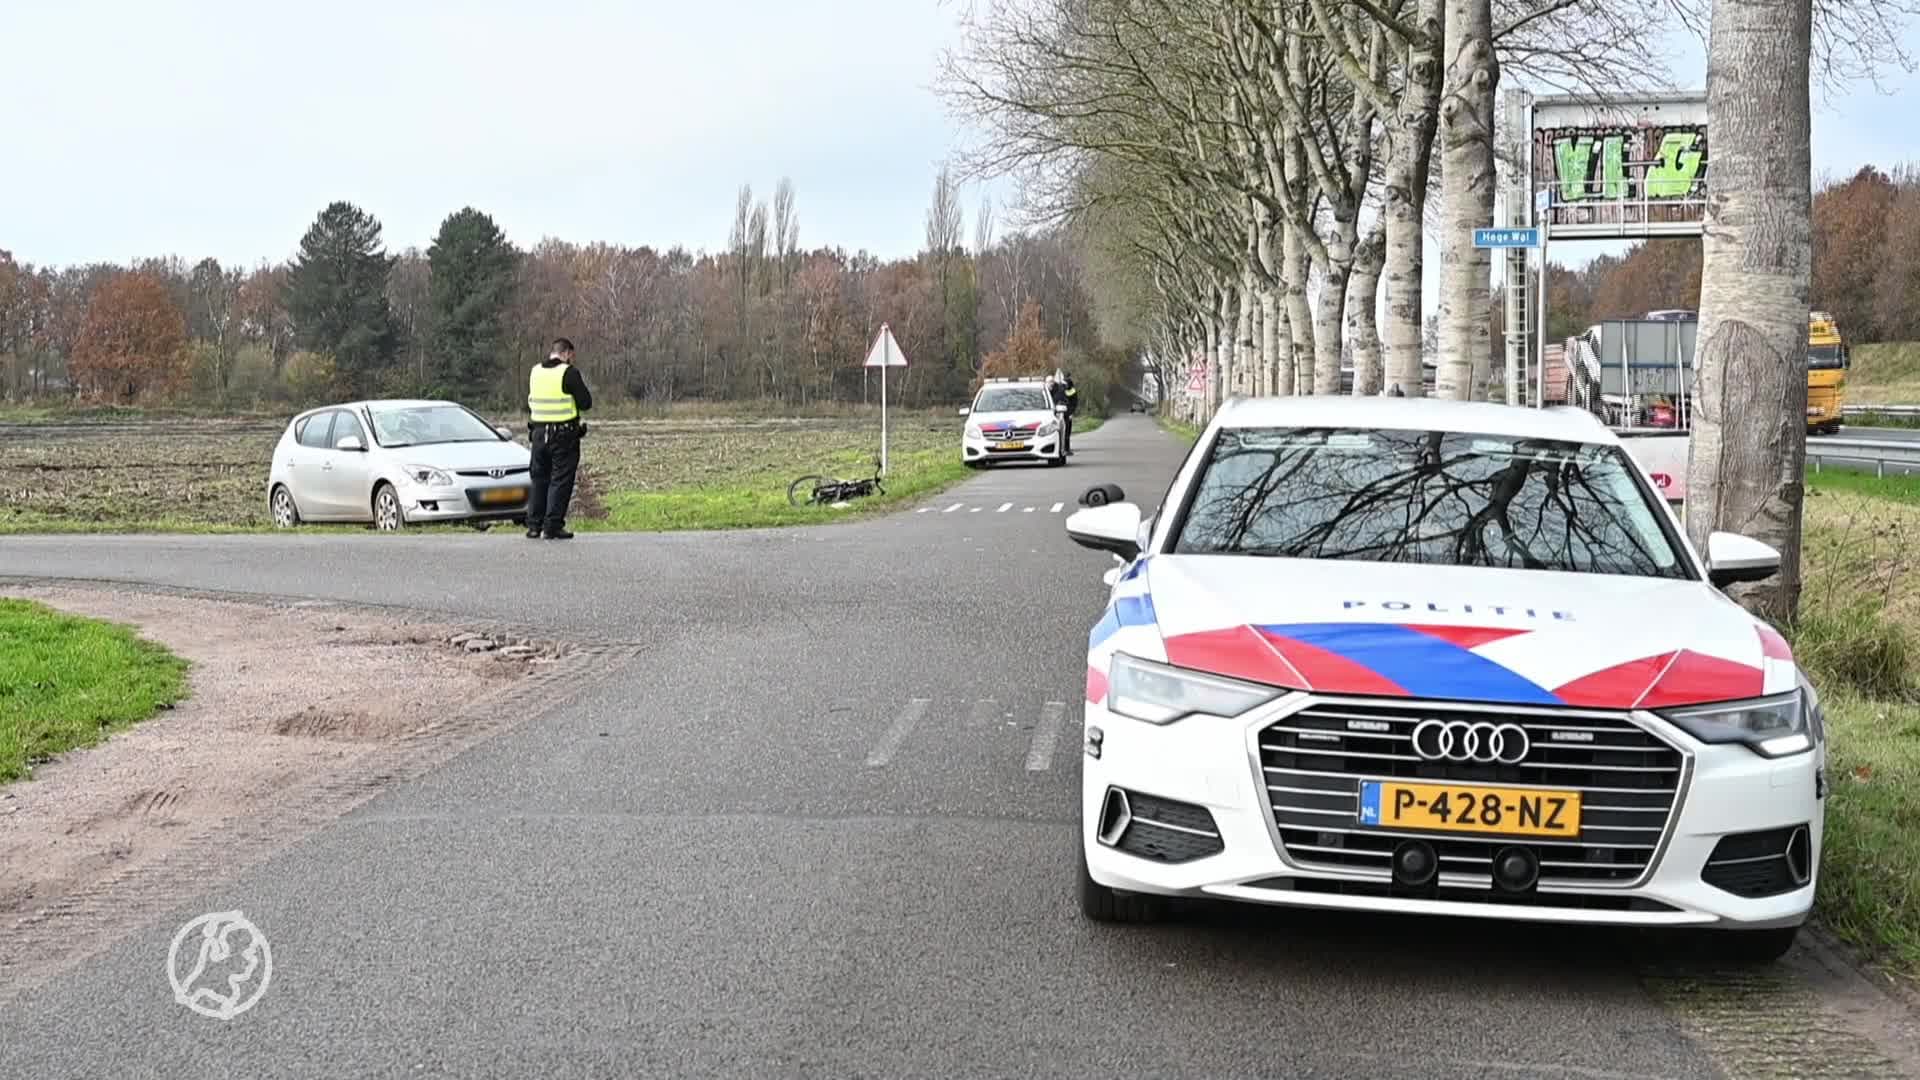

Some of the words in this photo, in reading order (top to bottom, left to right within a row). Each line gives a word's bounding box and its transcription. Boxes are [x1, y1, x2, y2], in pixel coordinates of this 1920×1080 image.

[1343, 600, 1577, 622] POLITIE
[1361, 806, 1377, 820] NL
[1394, 788, 1567, 830] P-428-NZ
